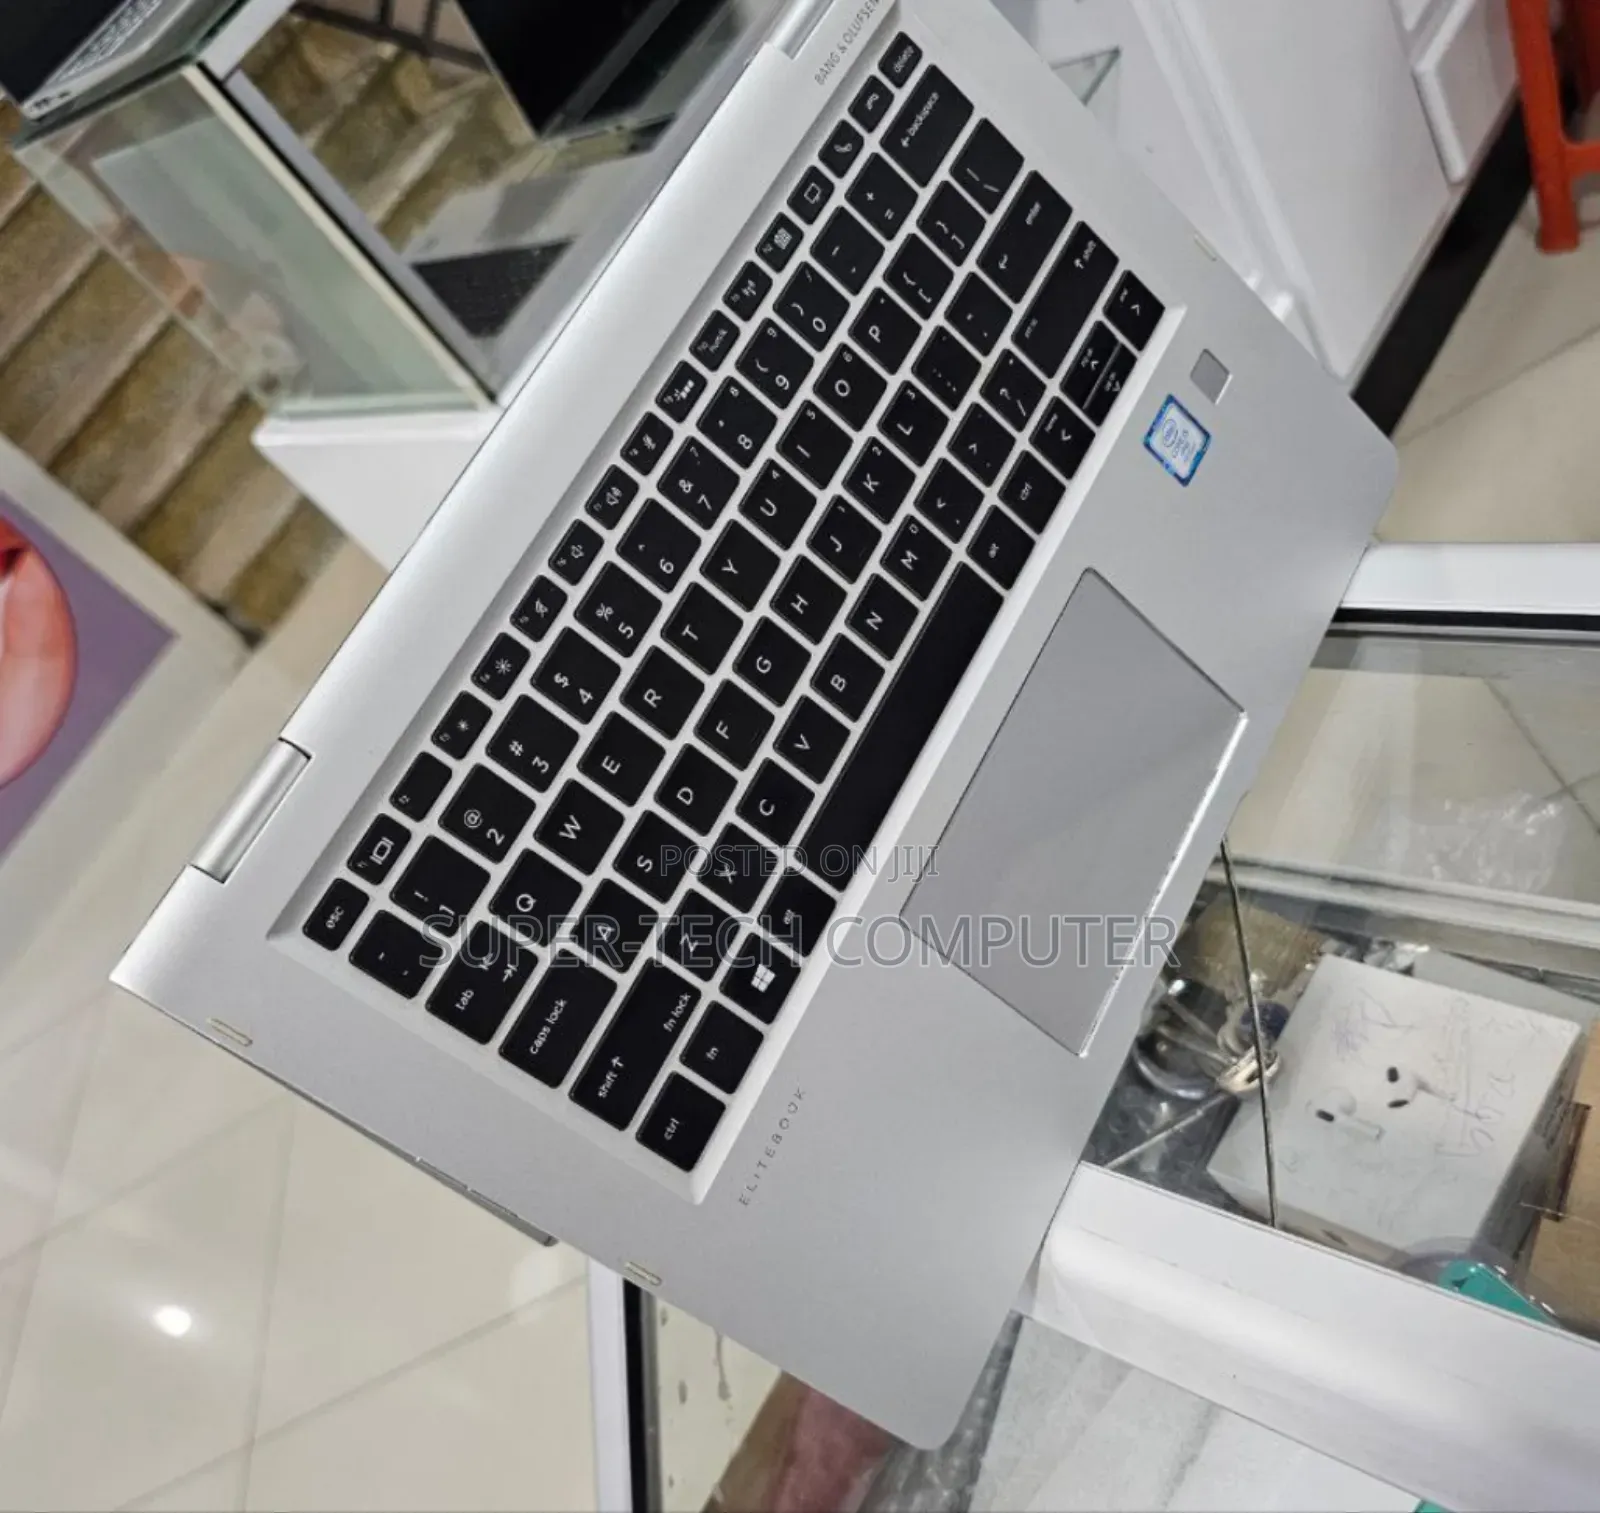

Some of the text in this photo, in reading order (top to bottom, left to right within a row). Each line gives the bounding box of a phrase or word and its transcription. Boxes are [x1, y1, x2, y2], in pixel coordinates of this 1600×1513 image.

[814, 51, 841, 86] BANG
[868, 324, 881, 344] P
[774, 374, 790, 391] 9
[896, 423, 914, 436] L
[736, 433, 754, 450] 8
[678, 478, 695, 494] &
[862, 472, 880, 494] K
[696, 493, 713, 511] 7
[759, 497, 778, 517] U
[829, 535, 843, 553] J
[658, 557, 675, 575] 6
[721, 558, 739, 575] Y
[900, 549, 919, 571] M
[595, 602, 615, 622] %
[790, 593, 809, 615] H
[617, 621, 634, 640] 5
[865, 611, 884, 631] N
[681, 623, 699, 641] T
[755, 655, 772, 675] G
[553, 672, 571, 689] $
[829, 673, 847, 693] B
[578, 687, 594, 705] 4
[643, 688, 663, 709] R
[715, 720, 730, 740] F
[508, 740, 524, 757] #
[793, 733, 811, 750] V
[531, 755, 550, 774] 3
[600, 755, 622, 775] E
[676, 786, 694, 806] D
[758, 798, 775, 817] C
[463, 808, 483, 830] @
[558, 814, 582, 840] W
[485, 827, 506, 846] 2
[636, 854, 654, 873] S
[515, 893, 537, 913] Q
[325, 905, 344, 930] esc
[596, 924, 616, 943] A
[680, 933, 699, 952] Z
[454, 989, 475, 1011] tab
[663, 993, 692, 1033] fn lock
[529, 998, 567, 1055] caps lock
[705, 1046, 719, 1061] fn
[597, 1071, 618, 1098] shift
[664, 1117, 680, 1141] ctrl
[738, 1086, 807, 1206] ELITEBOOK
